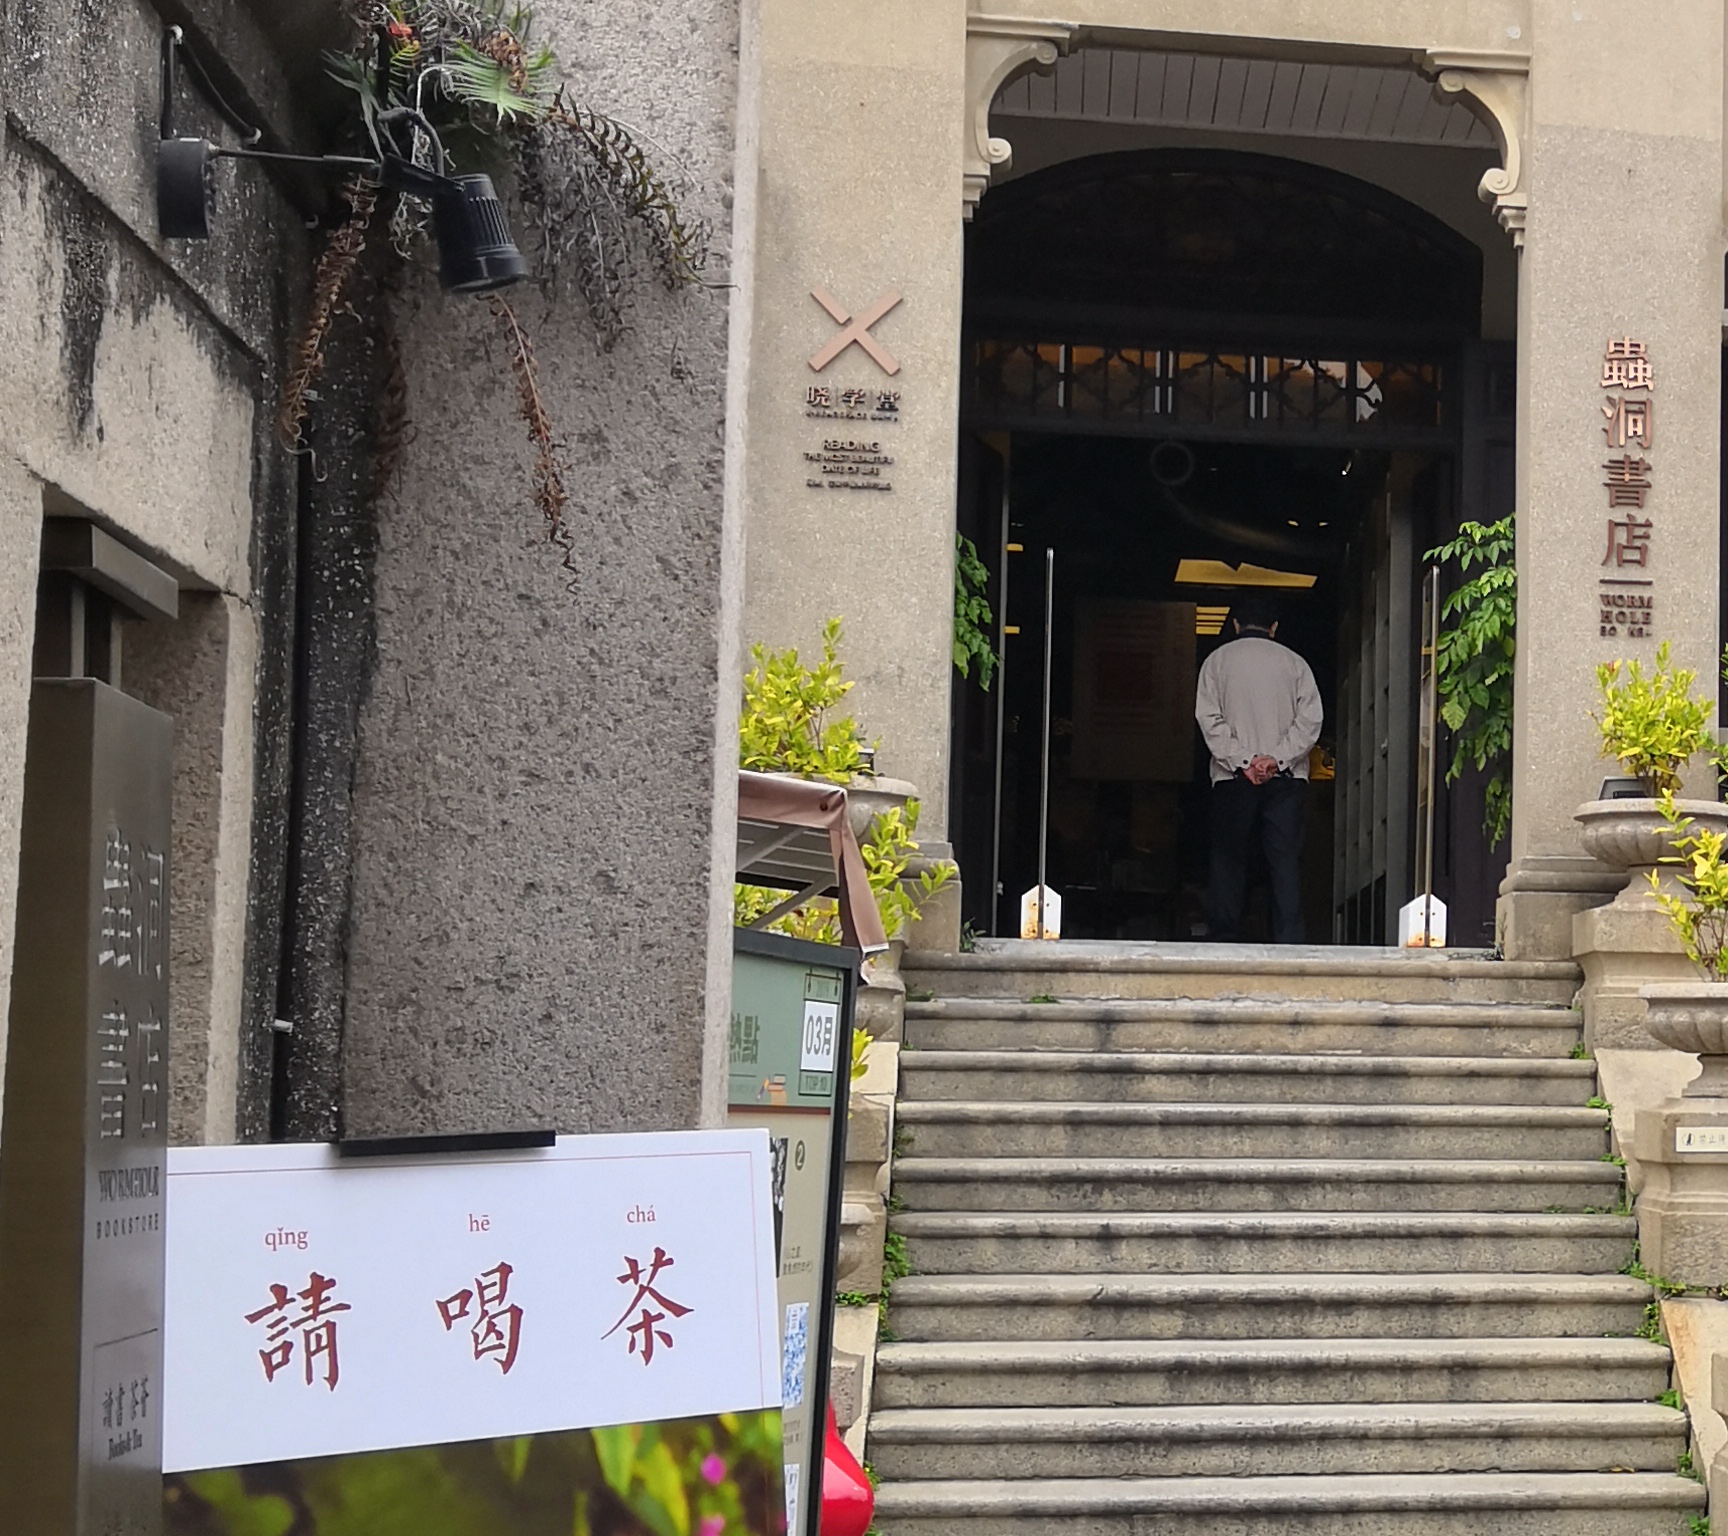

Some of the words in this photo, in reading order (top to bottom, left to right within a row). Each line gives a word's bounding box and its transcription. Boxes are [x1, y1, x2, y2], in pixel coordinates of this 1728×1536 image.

[823, 439, 880, 453] READING
[1601, 335, 1654, 568] 蟲洞書店
[1599, 594, 1653, 609] WORM
[1600, 610, 1651, 624] HOLE
[805, 1015, 833, 1056] 03月
[97, 997, 162, 1141] 書店
[99, 1166, 159, 1203] WORMHOLE
[96, 1213, 158, 1240] BOOKSTORE
[264, 1226, 309, 1251] qǐng
[468, 1212, 491, 1233] hē
[626, 1204, 657, 1223] chá
[244, 1246, 695, 1392] 請喝茶
